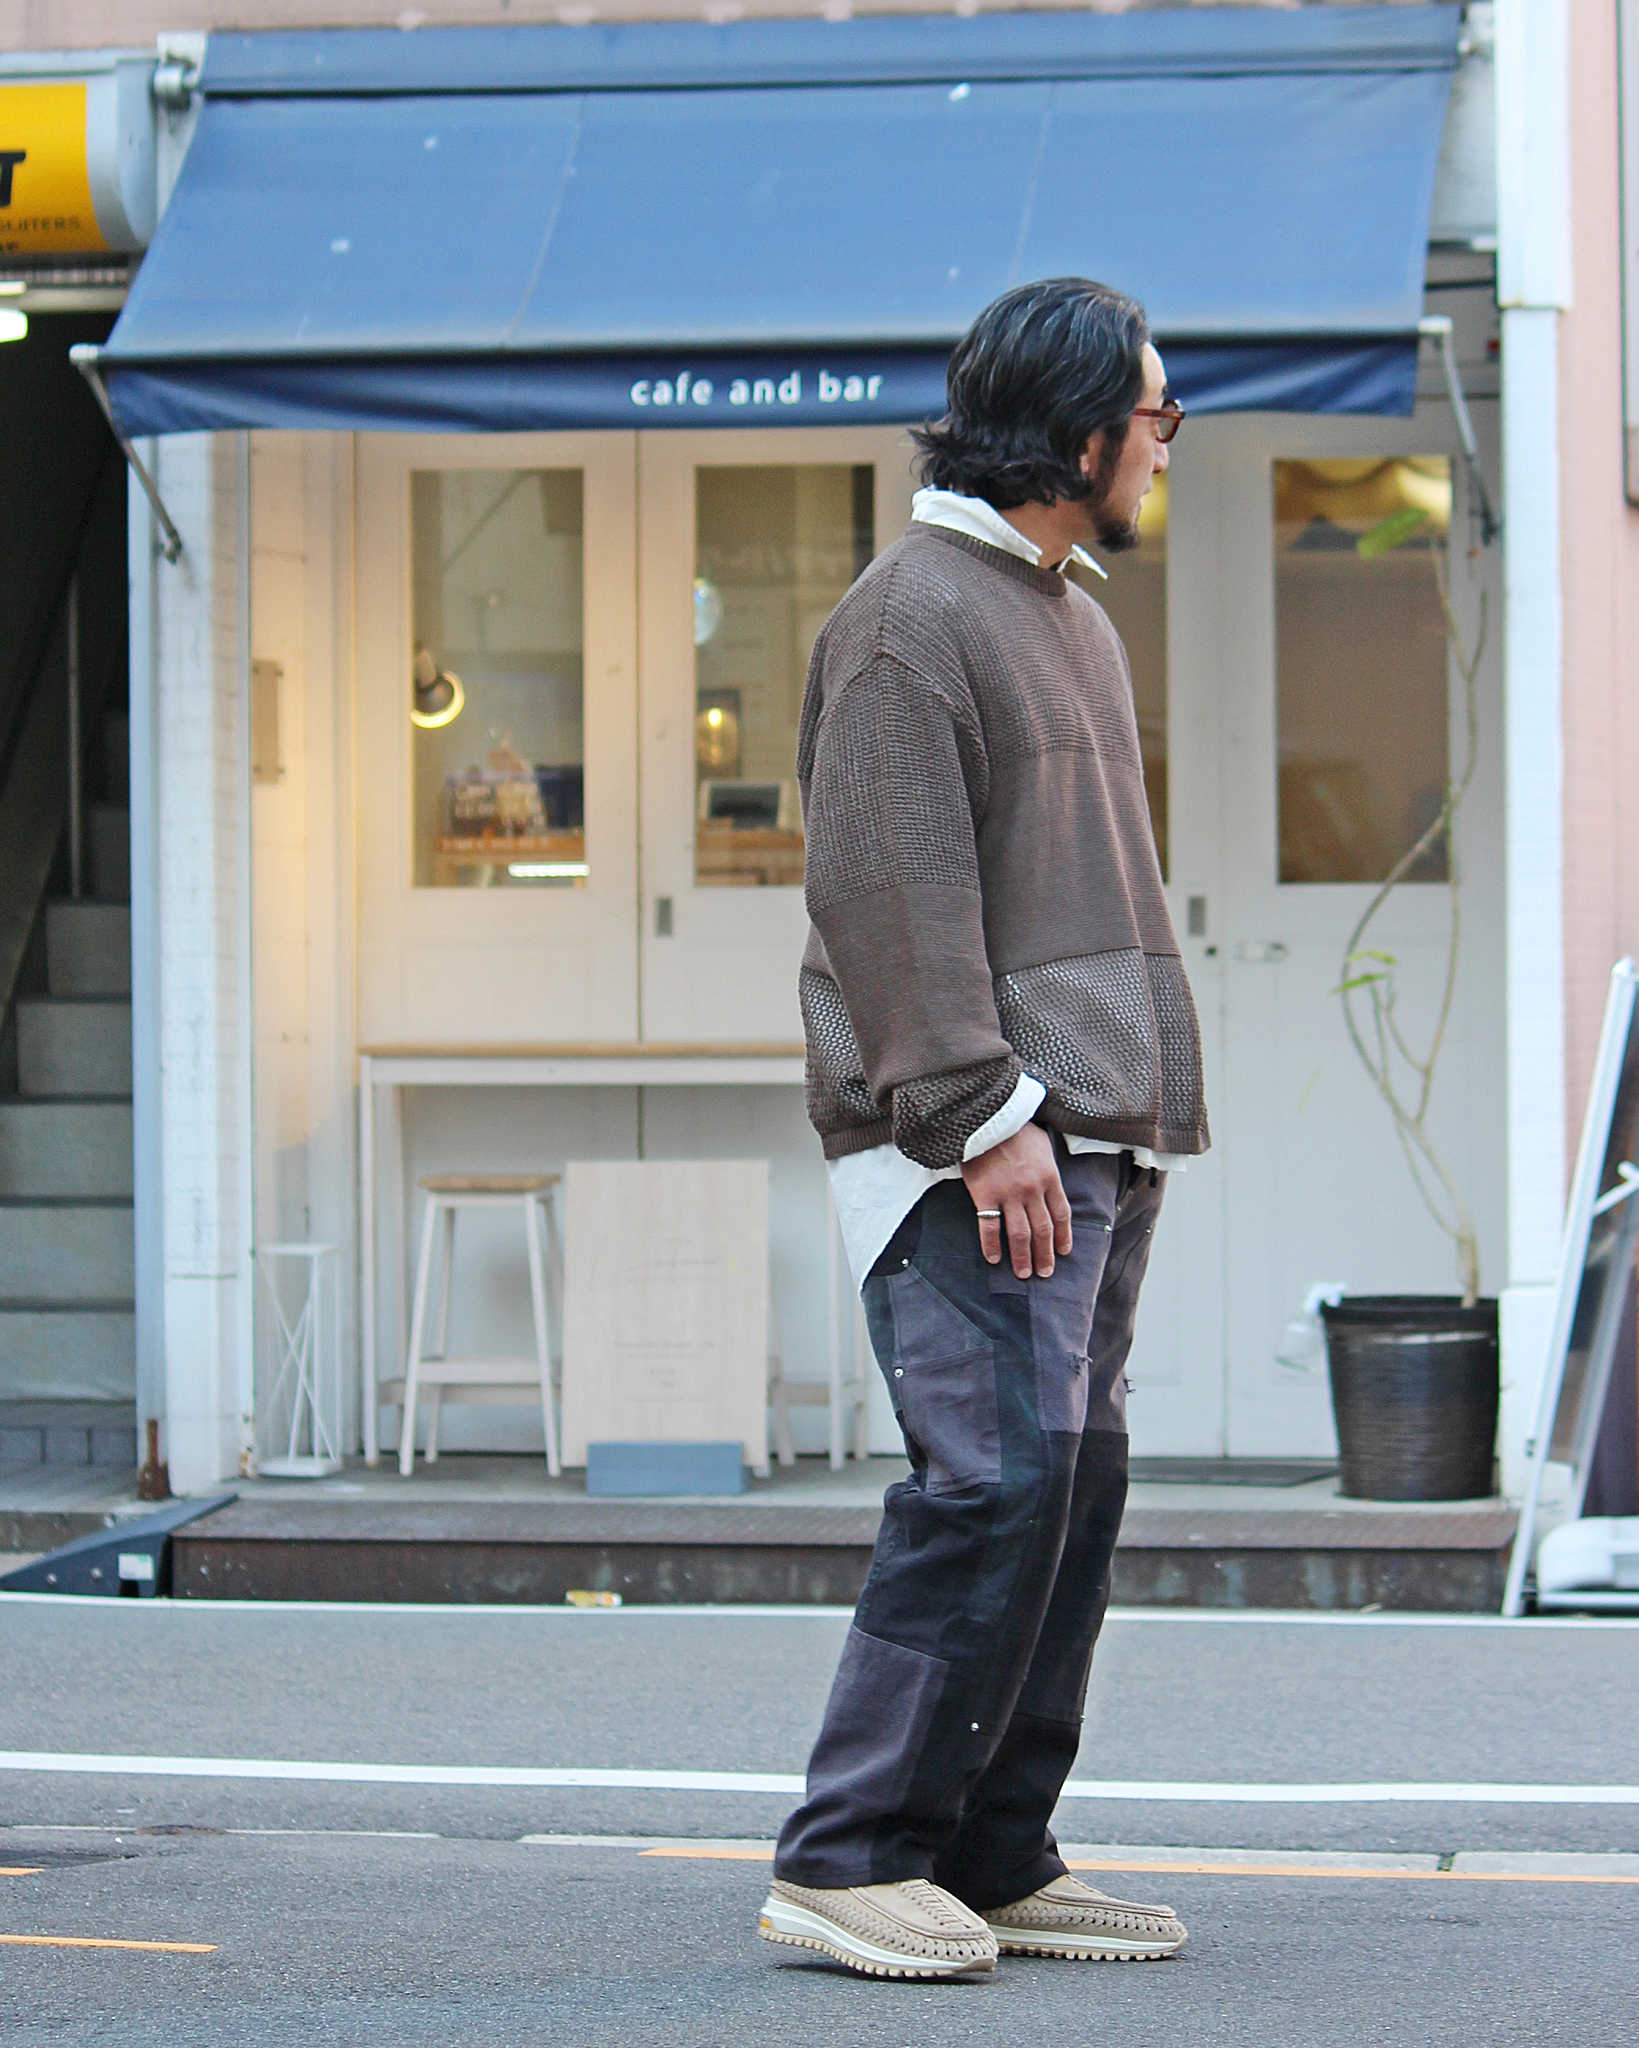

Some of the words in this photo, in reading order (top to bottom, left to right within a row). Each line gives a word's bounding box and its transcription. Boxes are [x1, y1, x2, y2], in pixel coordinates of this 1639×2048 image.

[630, 370, 713, 406] cafe
[729, 370, 802, 405] and
[818, 369, 883, 403] bar
